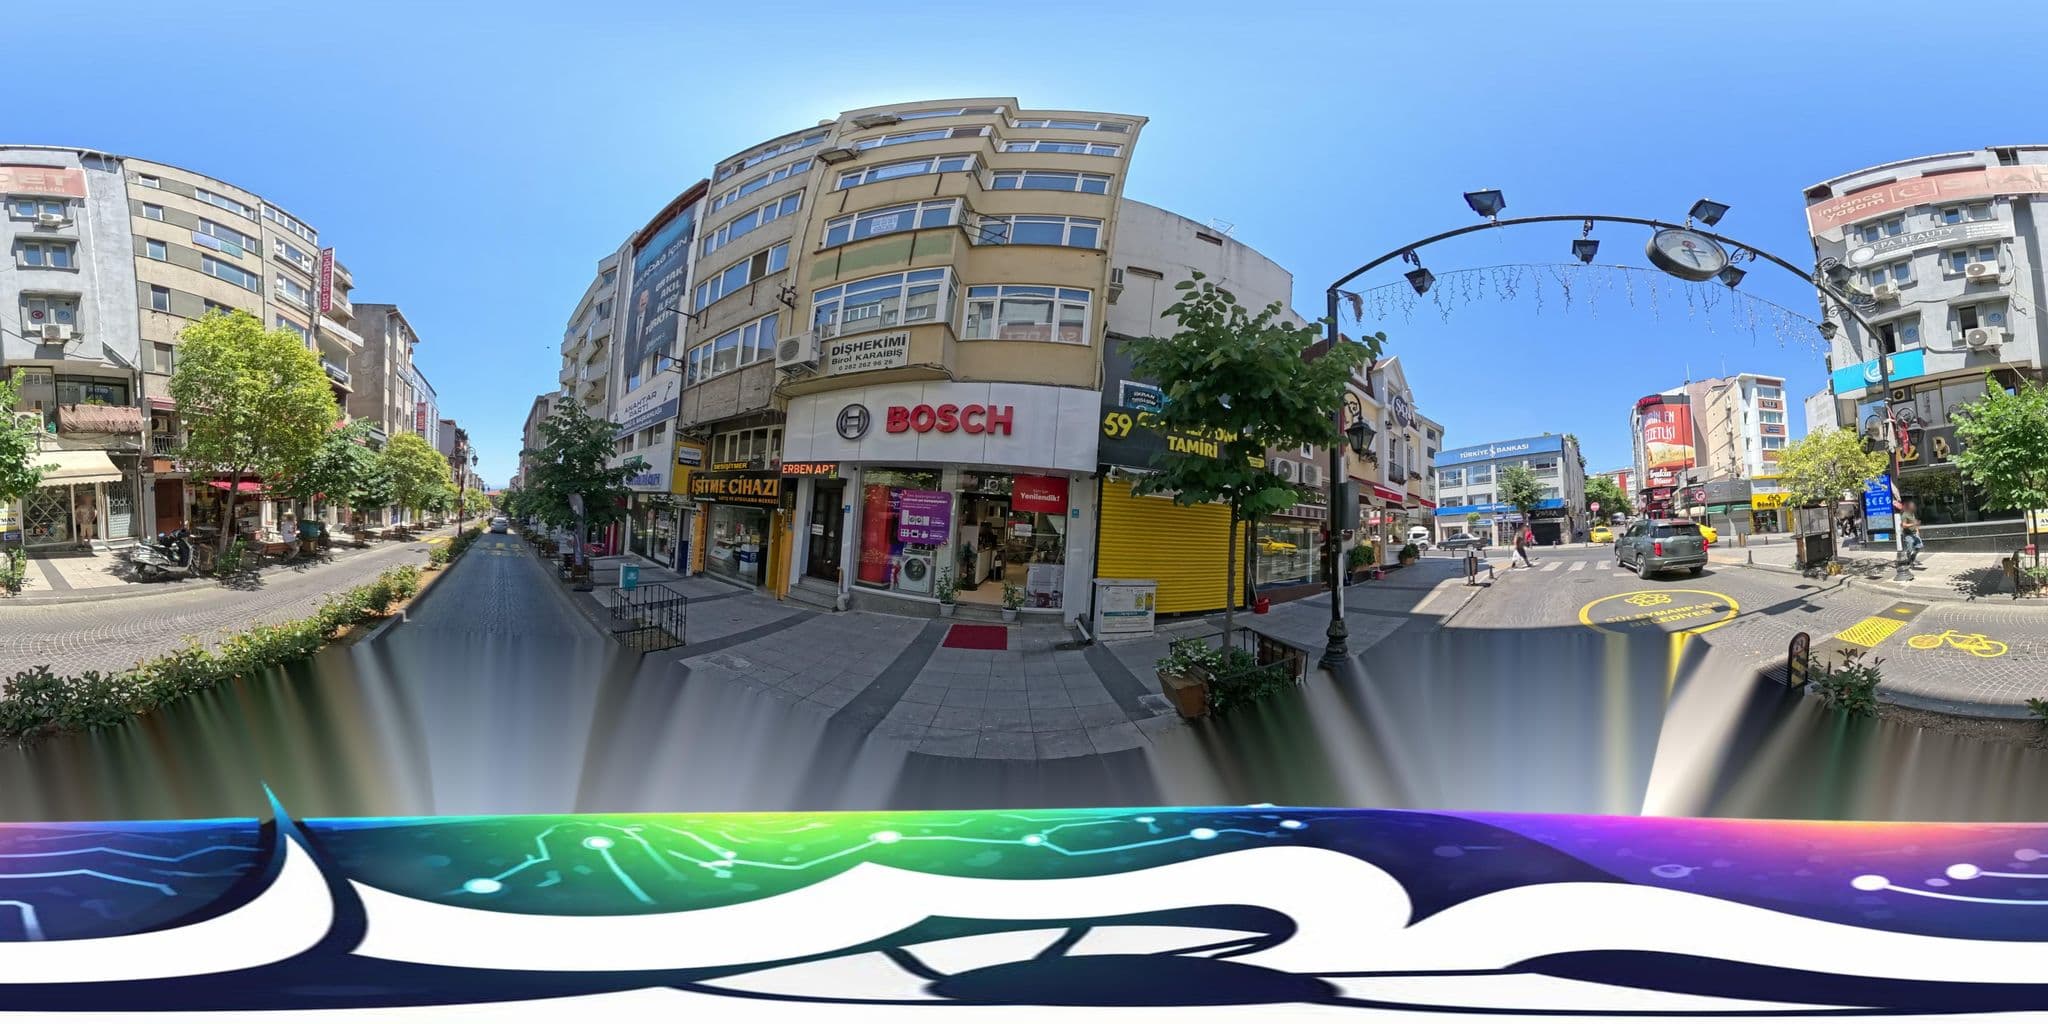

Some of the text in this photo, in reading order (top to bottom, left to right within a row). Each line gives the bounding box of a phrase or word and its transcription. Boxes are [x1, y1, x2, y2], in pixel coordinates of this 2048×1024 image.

[831, 333, 907, 356] DİŞHEKİMİ
[831, 356, 852, 365] Birol
[885, 403, 1014, 436] BOSCH
[1104, 412, 1133, 437] 59
[1167, 435, 1218, 458] TAMİRİ
[1460, 443, 1529, 459] TÜRKİYE BANKASI
[691, 474, 778, 497] İŞİTME CİHAZI
